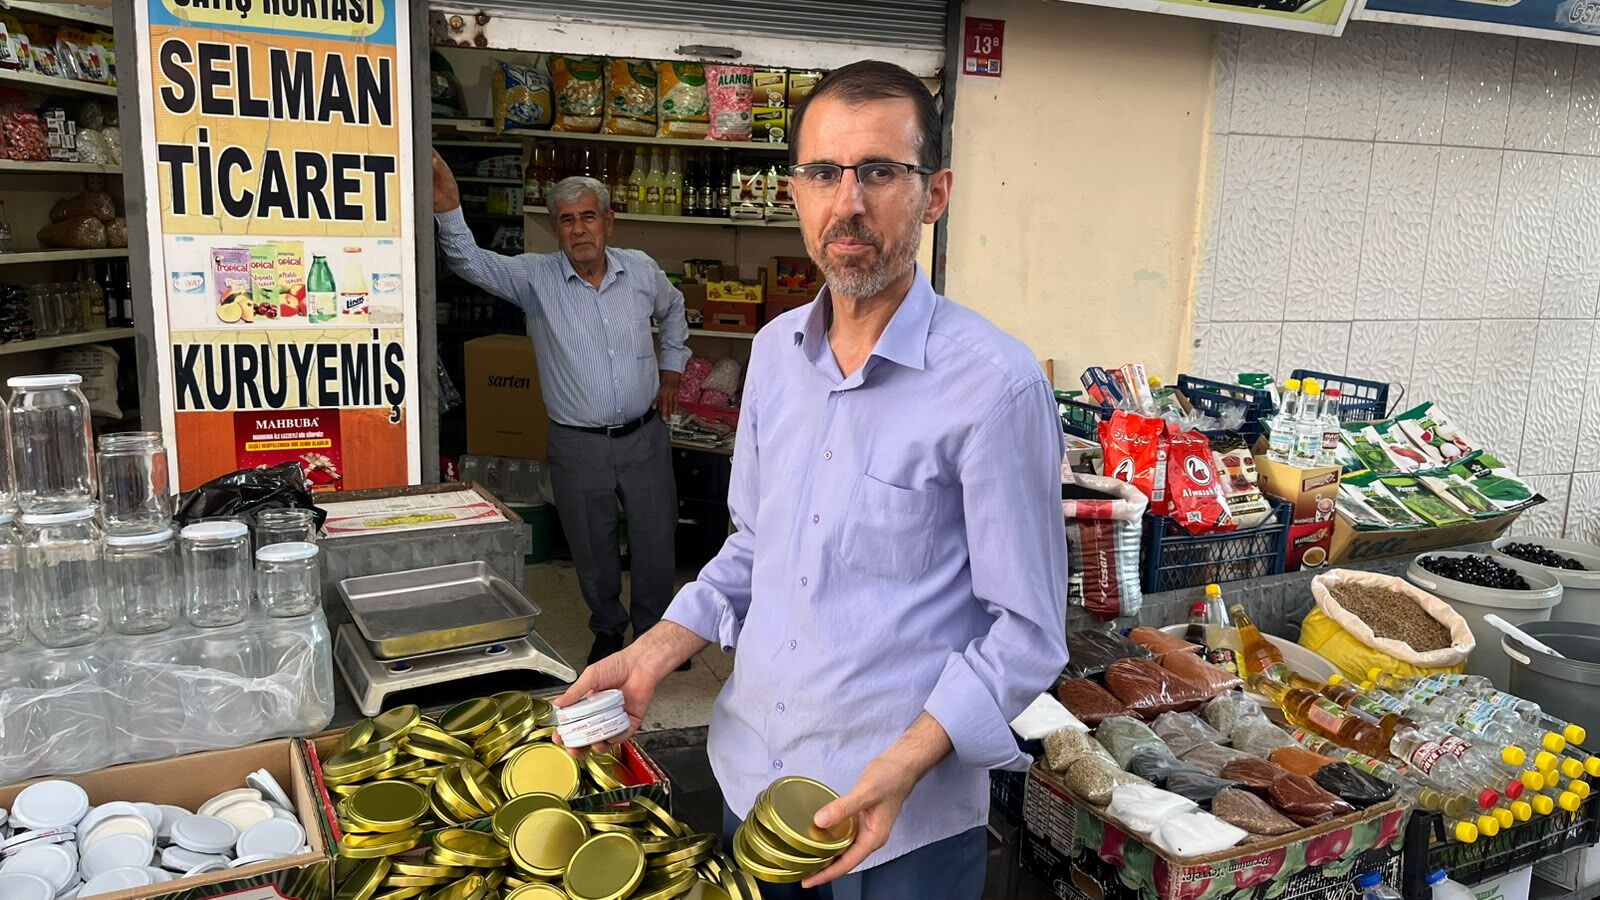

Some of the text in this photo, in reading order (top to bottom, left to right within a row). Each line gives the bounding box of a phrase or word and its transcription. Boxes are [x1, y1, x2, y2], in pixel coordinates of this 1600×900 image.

[160, 38, 392, 126] SELMAN
[158, 128, 396, 221] TİCARET
[173, 328, 406, 423] KURUYEMİŞ
[488, 375, 530, 389] sarten
[256, 418, 319, 430] MAHBUBA
